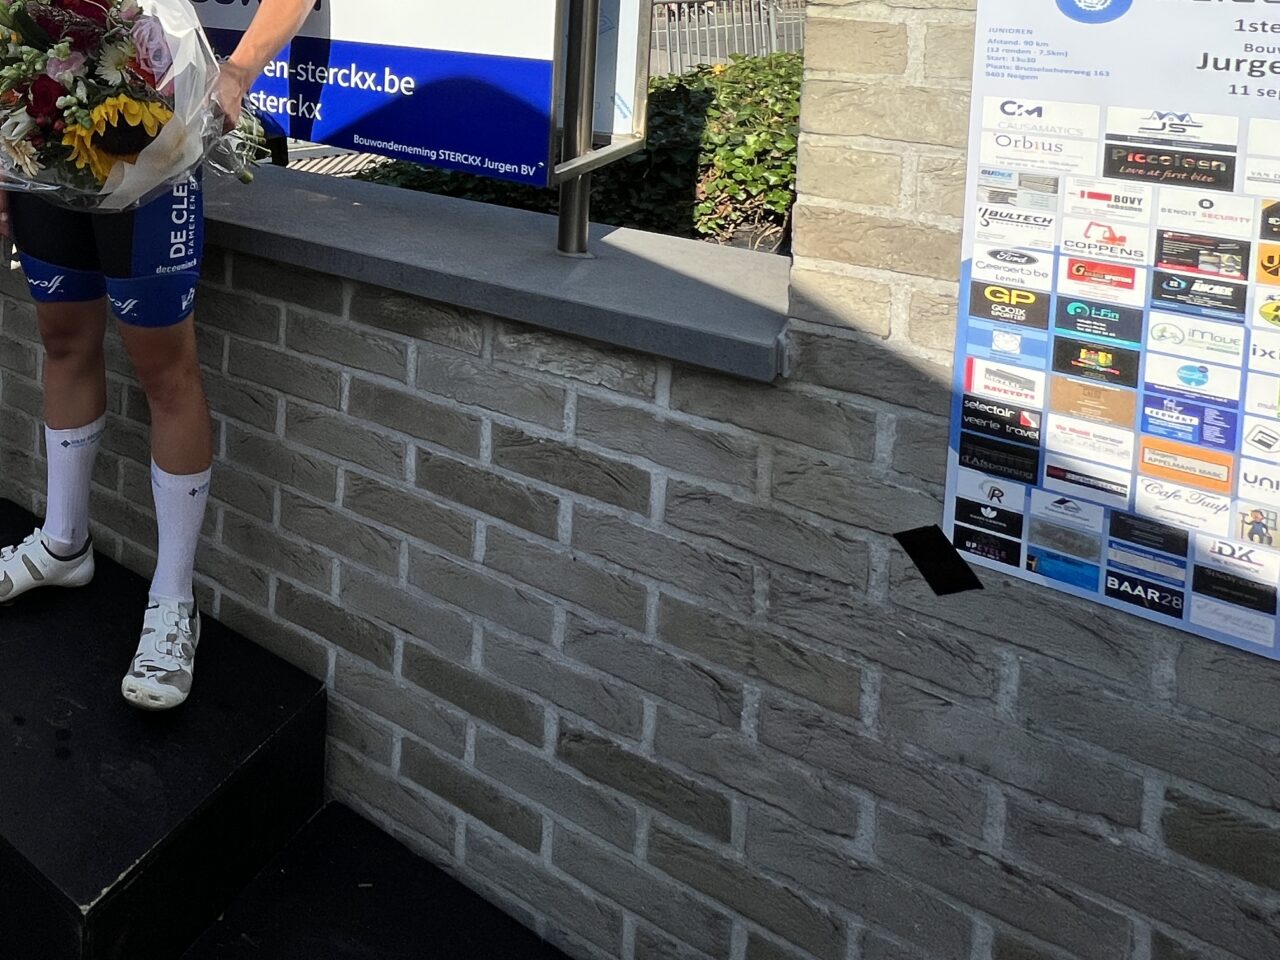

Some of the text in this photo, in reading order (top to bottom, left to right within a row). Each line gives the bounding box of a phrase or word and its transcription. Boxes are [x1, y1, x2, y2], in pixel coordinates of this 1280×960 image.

[1234, 19, 1280, 34] 1ste
[1196, 52, 1280, 78] Jurge
[1228, 84, 1250, 96] 11
[995, 134, 1064, 153] Orbius
[354, 134, 536, 176] Bouwonderneming STERCKX Jurgen BV
[1119, 165, 1215, 183] Love at first bite
[189, 195, 196, 210] EN
[1114, 194, 1144, 206] BOVY
[988, 210, 1054, 225] BULTECH
[187, 215, 195, 255] RAMEN
[170, 230, 187, 259] DE
[1064, 239, 1145, 258] COPPENS
[996, 251, 1029, 264] Ford
[995, 273, 1026, 285] Lennik
[984, 285, 1037, 306] GP
[964, 400, 1016, 418] selectair
[963, 415, 1040, 441] veerle travel
[1107, 576, 1183, 609] BAAR28
